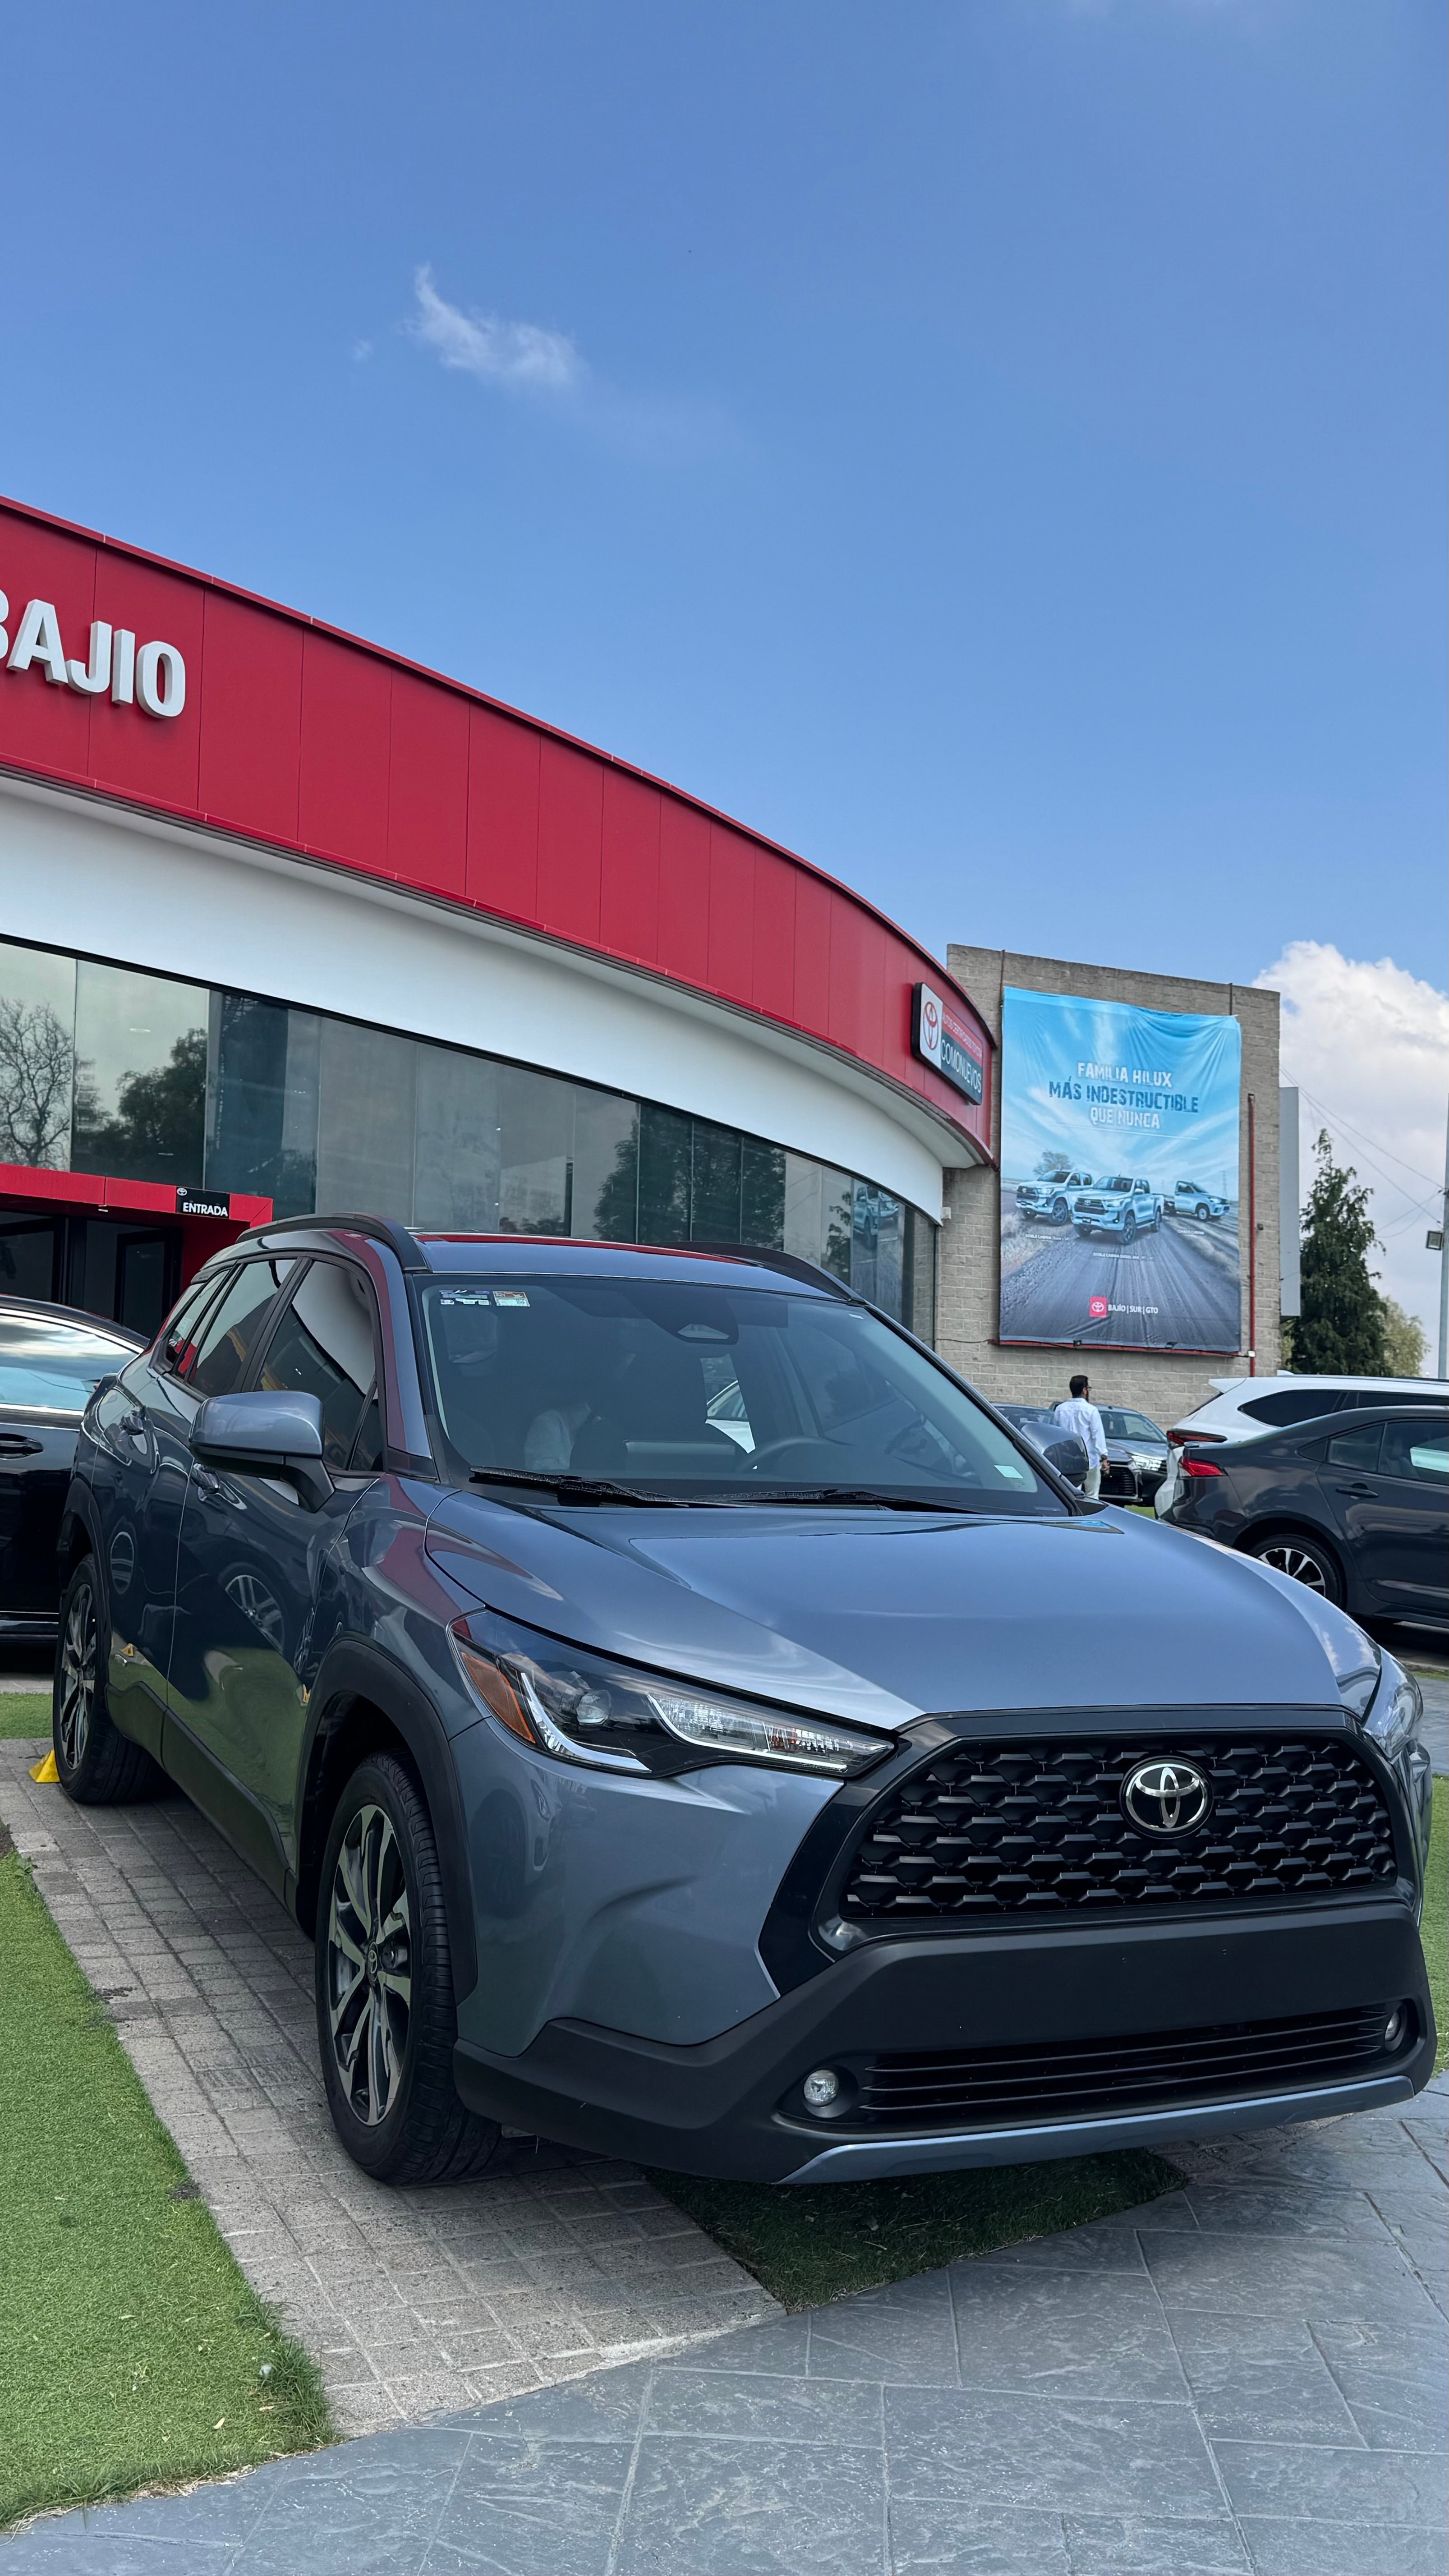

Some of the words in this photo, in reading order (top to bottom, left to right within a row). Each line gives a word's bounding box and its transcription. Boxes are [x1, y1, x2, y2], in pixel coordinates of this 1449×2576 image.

[0, 589, 186, 719] AJIO
[1077, 1062, 1128, 1082] FAMILIA
[1132, 1070, 1172, 1088] HILUX
[1049, 1076, 1082, 1100] MÁS
[1086, 1086, 1199, 1113] INDESTRUCTIBLE
[1090, 1107, 1113, 1125] QUE
[1117, 1111, 1160, 1129] NUNCA
[183, 1202, 228, 1217] ENTRADA
